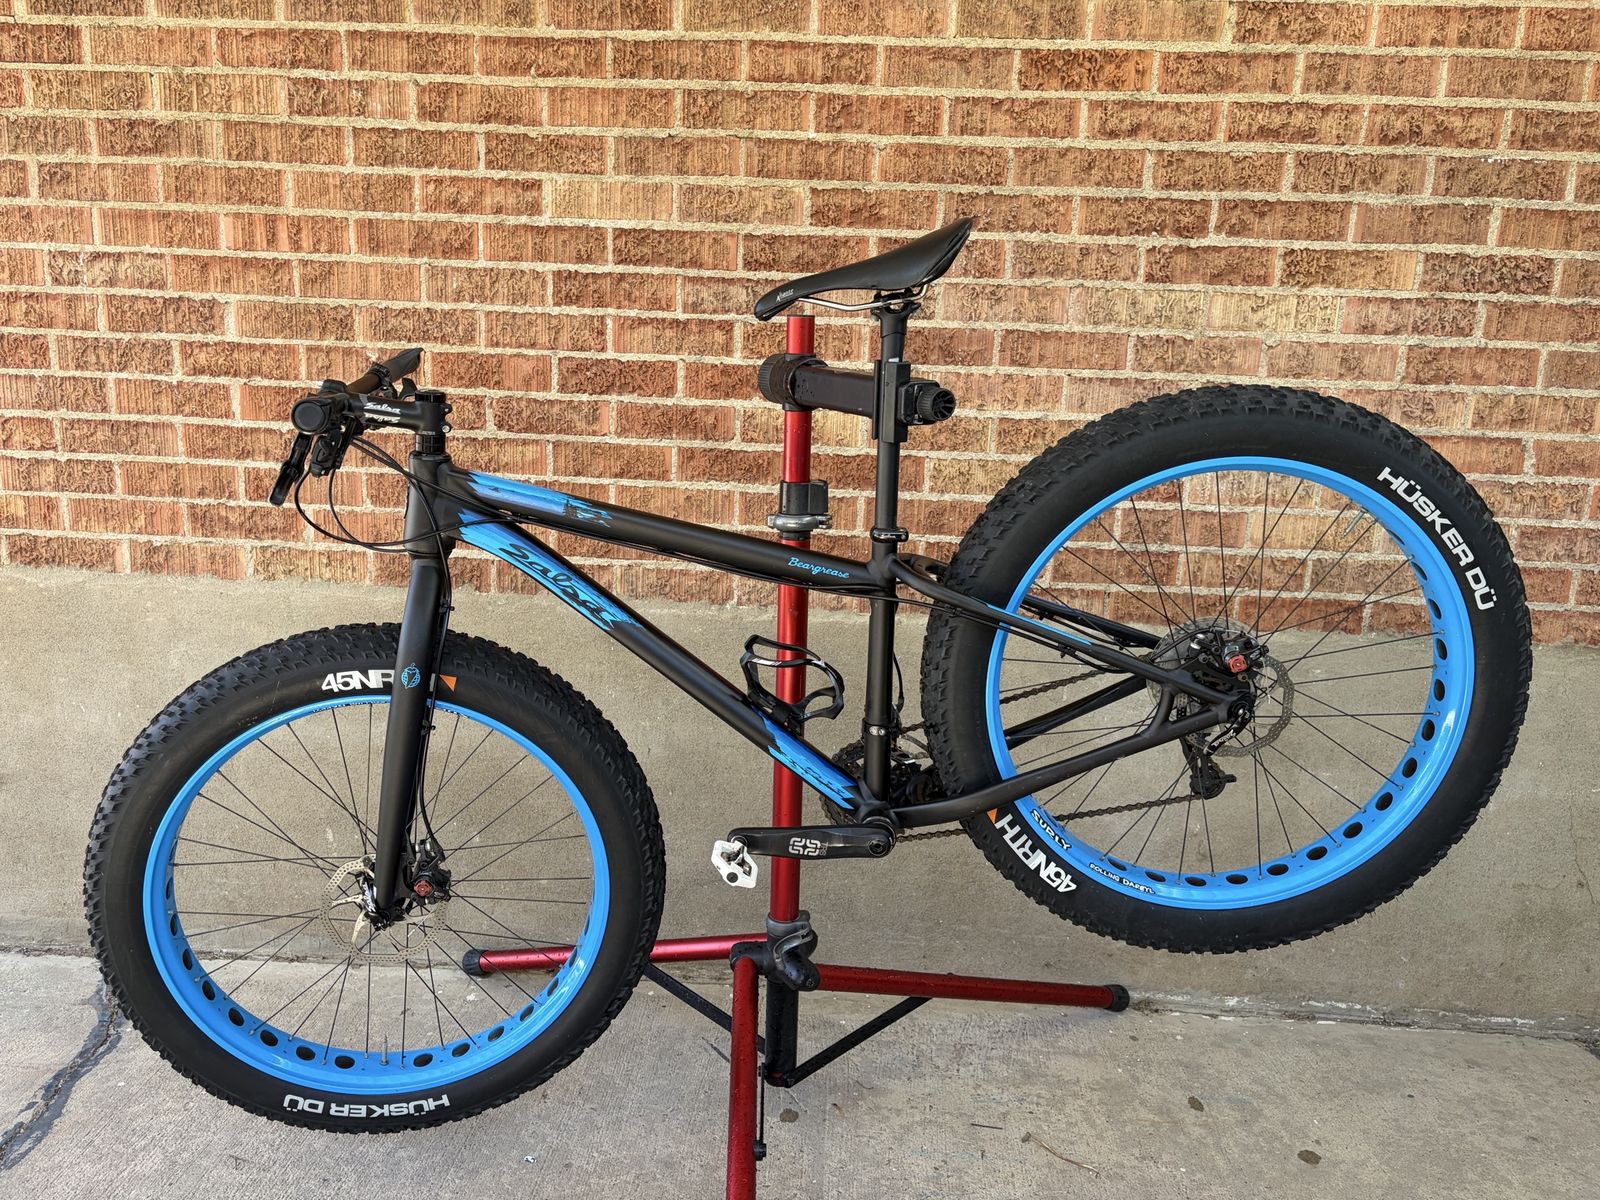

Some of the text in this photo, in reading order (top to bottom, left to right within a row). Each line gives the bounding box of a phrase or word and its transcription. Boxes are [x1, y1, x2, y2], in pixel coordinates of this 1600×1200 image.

[363, 402, 401, 415] Salsa
[1376, 466, 1498, 611] HÜSKER DÜ
[788, 556, 850, 580] Beargrease
[321, 669, 395, 693] 45NR
[1031, 808, 1072, 851] SURLY
[994, 813, 1078, 893] 45NRTH
[282, 1093, 451, 1118] HÜSKER DÜ
